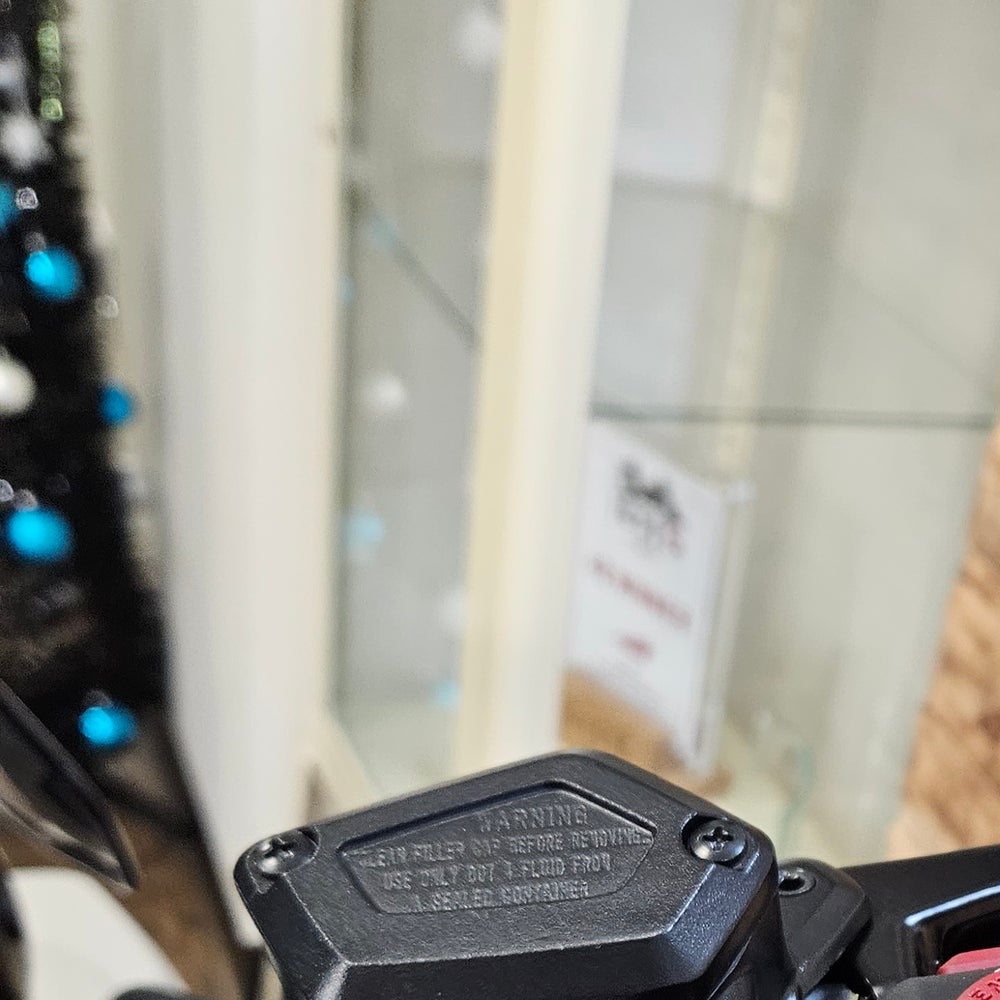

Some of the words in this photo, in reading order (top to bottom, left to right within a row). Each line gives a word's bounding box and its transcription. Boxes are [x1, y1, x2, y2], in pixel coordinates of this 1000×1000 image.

[479, 804, 589, 833] WARNING
[510, 832, 563, 854] BEFORE
[383, 870, 412, 890] USE
[467, 862, 494, 883] DOT
[519, 856, 565, 879] FLUID
